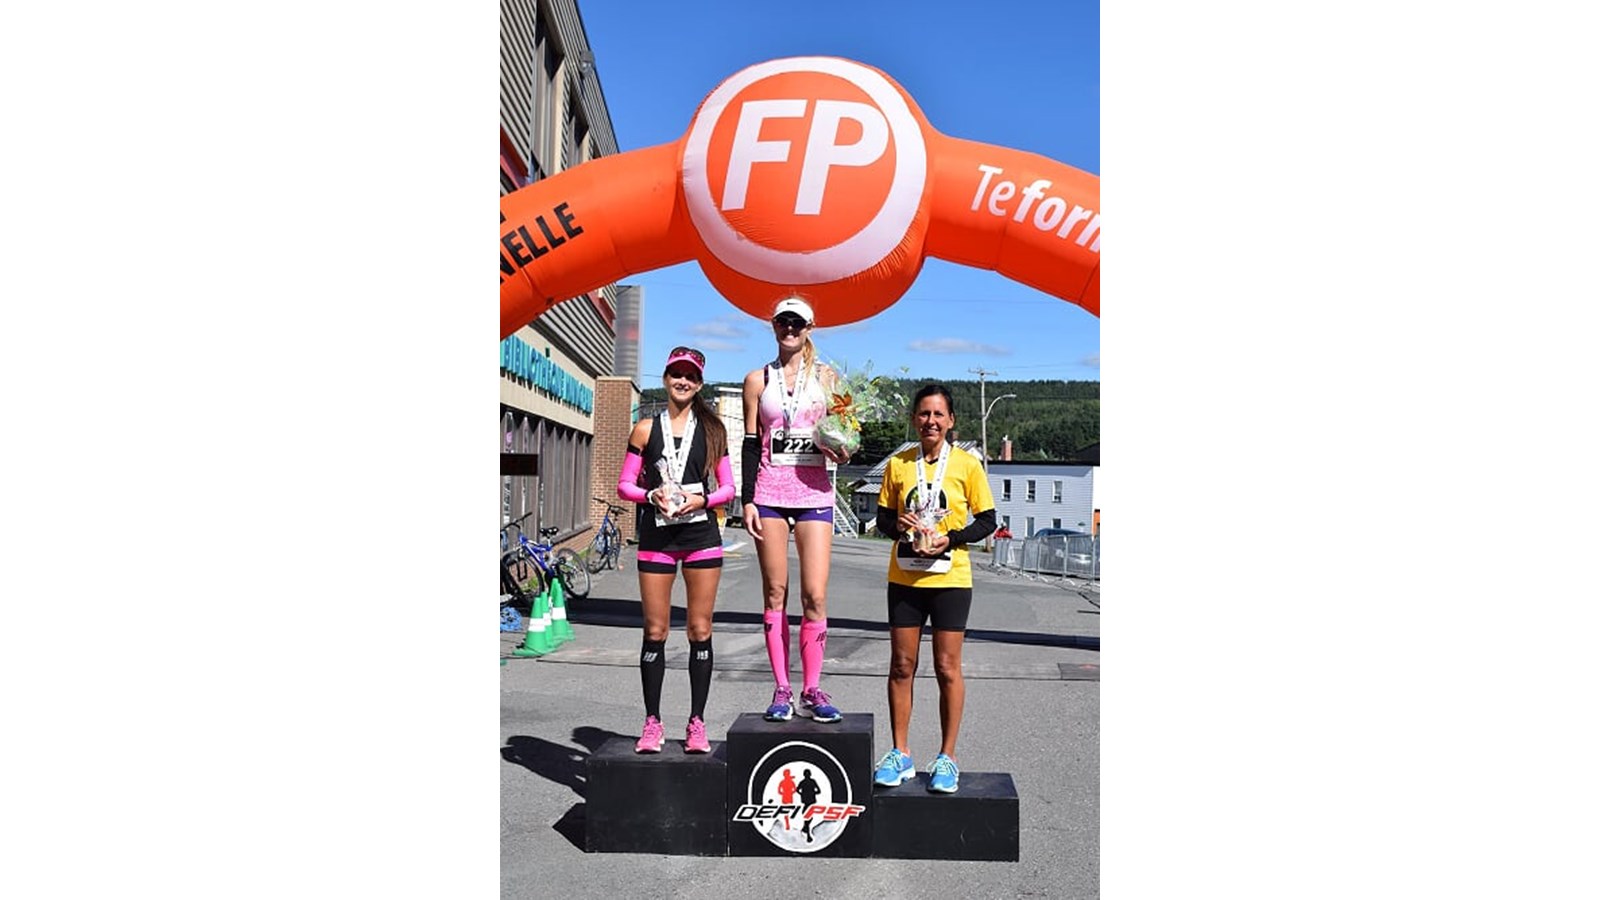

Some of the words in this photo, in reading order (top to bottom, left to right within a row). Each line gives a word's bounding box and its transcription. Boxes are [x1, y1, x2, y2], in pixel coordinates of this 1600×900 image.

[721, 99, 889, 215] FP
[783, 438, 814, 453] 222
[803, 804, 863, 820] PSF
